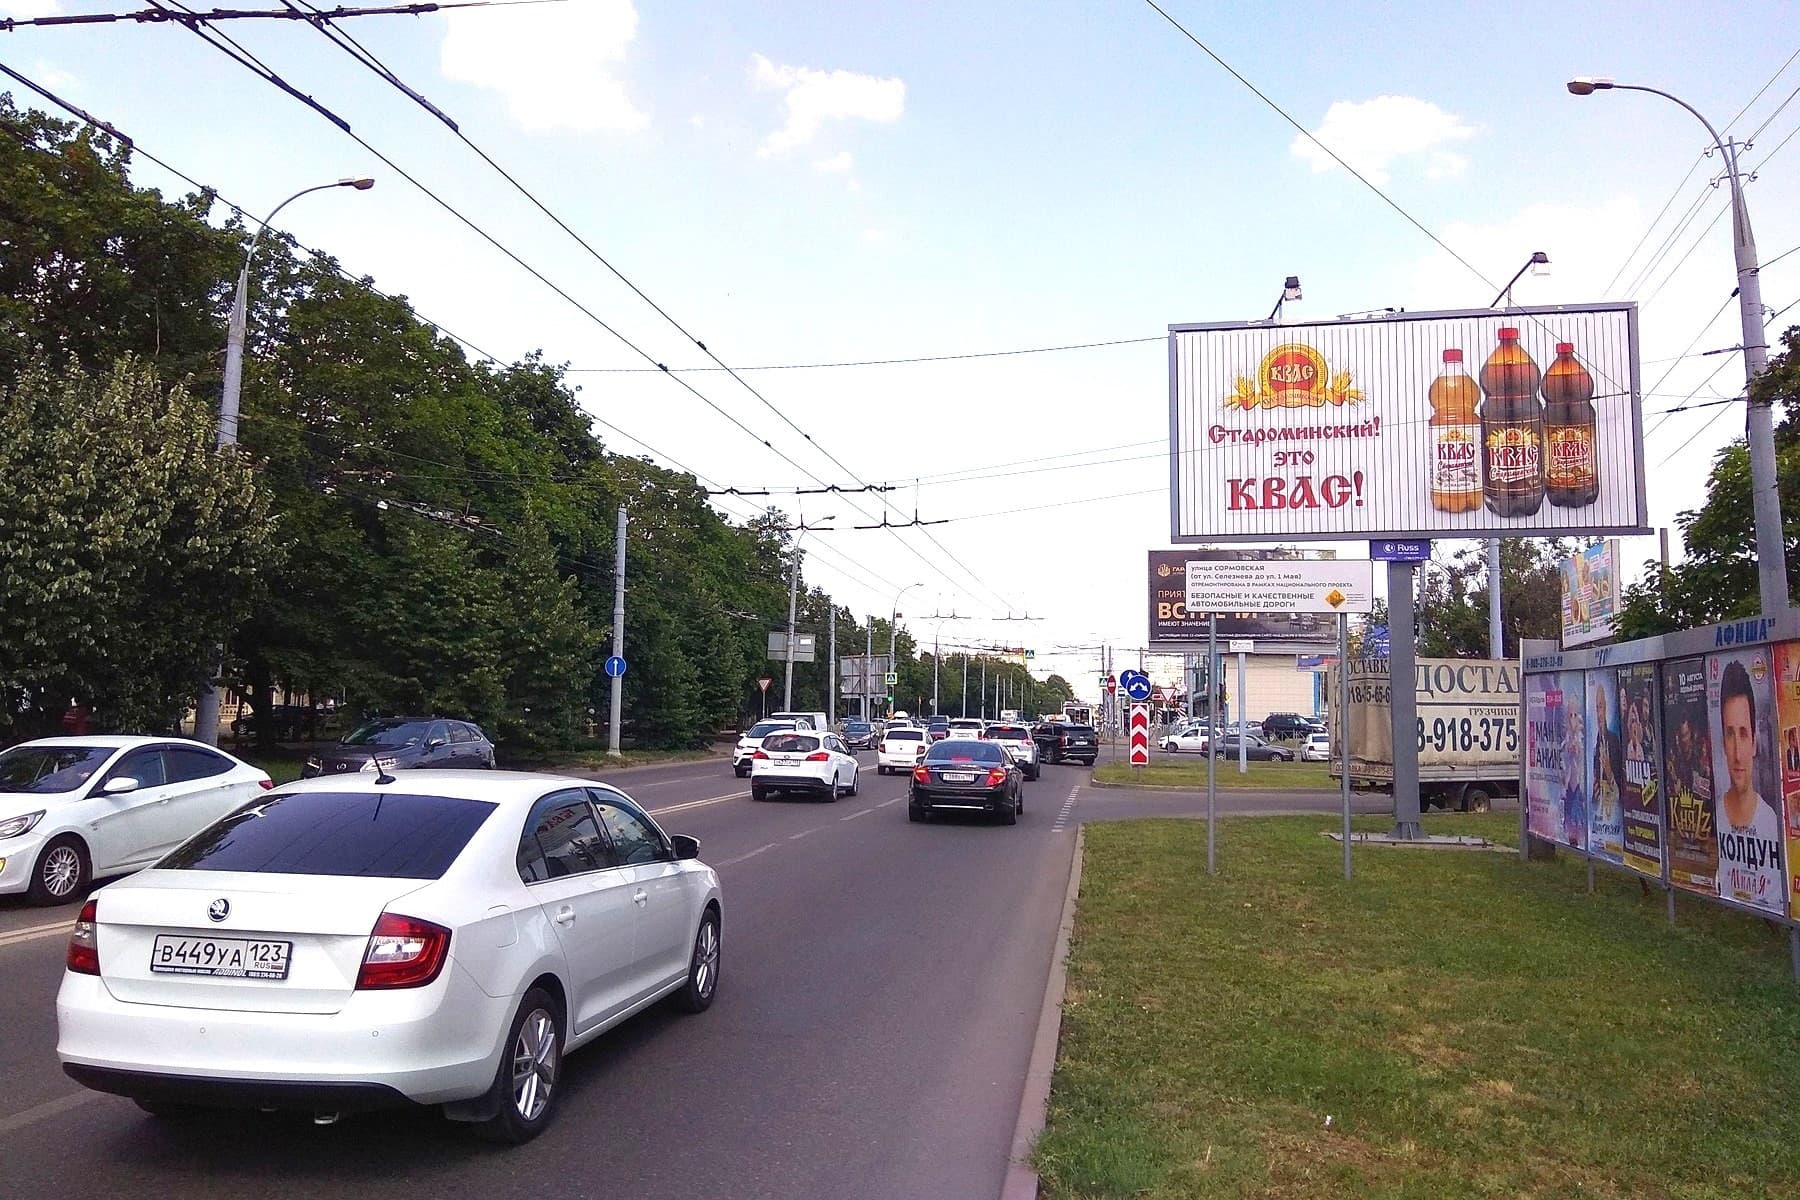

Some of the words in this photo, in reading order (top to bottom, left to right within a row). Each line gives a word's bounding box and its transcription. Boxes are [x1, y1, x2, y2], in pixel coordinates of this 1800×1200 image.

[1208, 416, 1381, 447] Староминский!
[1489, 445, 1539, 468] КВАС
[1227, 470, 1365, 511] КВАС!
[1397, 543, 1420, 552] Russ
[1415, 664, 1519, 699] ДОСТА
[1469, 707, 1517, 716] ГРУЗЧИКИ
[1719, 832, 1781, 870] КОЛДУН
[161, 941, 242, 967] В449УА
[249, 943, 282, 962] 123
[254, 961, 271, 970] RUS
